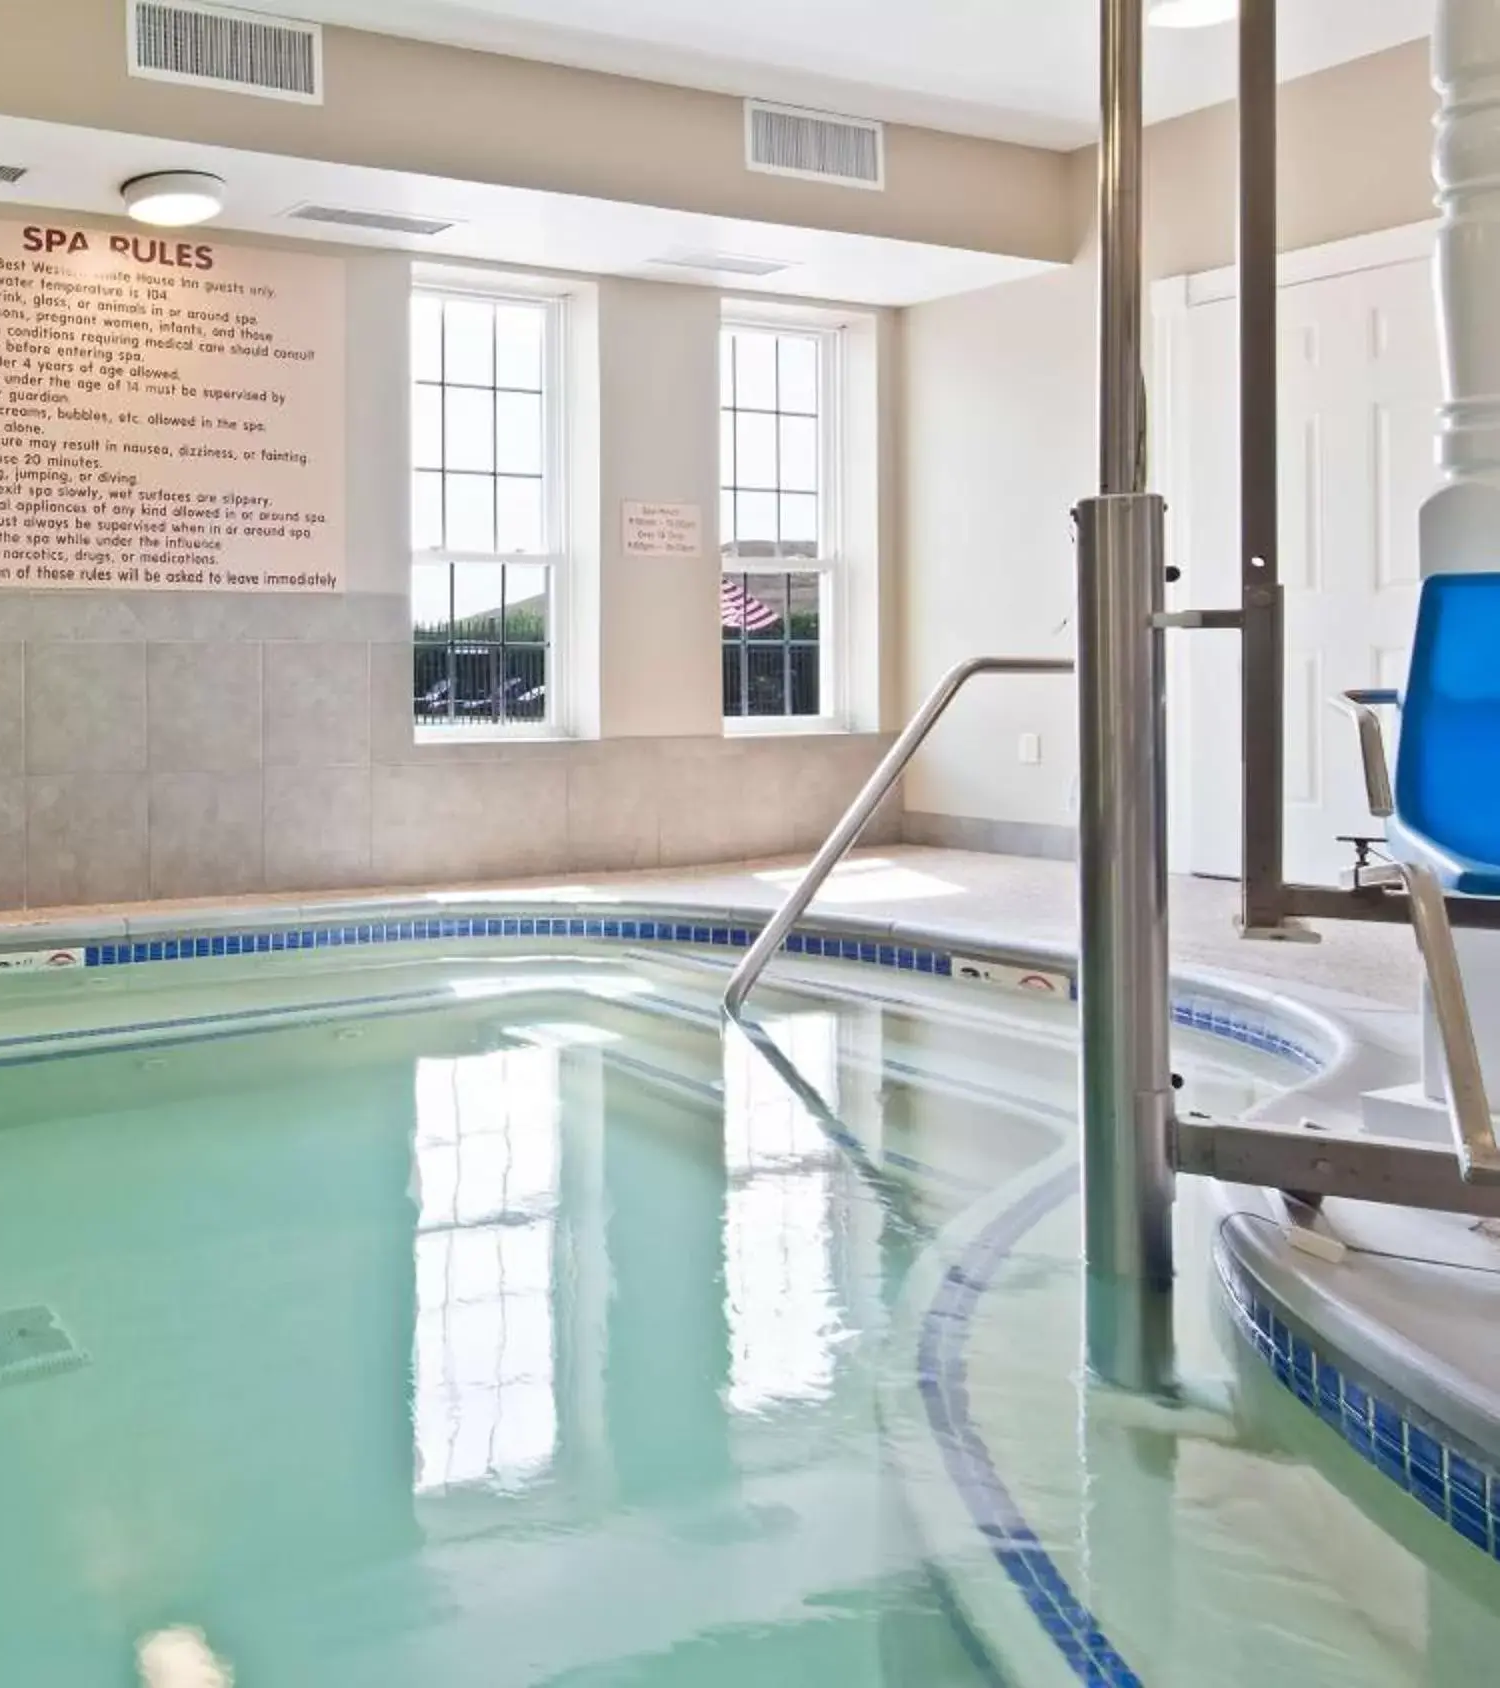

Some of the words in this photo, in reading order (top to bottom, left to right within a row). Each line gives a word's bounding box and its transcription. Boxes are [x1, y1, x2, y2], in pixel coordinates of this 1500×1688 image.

[23, 227, 89, 255] SPA
[109, 237, 212, 268] RULES
[129, 286, 138, 298] is
[77, 301, 90, 309] or
[151, 304, 162, 315] in
[168, 309, 181, 317] or
[187, 311, 229, 321] around
[36, 314, 96, 327] pregnant
[212, 327, 234, 338] and
[7, 327, 74, 340] conditions
[81, 333, 139, 349] requiring
[5, 340, 50, 354] before
[57, 347, 112, 362] entering
[22, 358, 30, 369] 4
[37, 362, 73, 373] years
[99, 367, 123, 378] age
[4, 373, 42, 385] under
[49, 376, 70, 387] the
[77, 381, 100, 392] age
[107, 380, 120, 391] of
[145, 386, 176, 395] must
[181, 385, 196, 396] be
[271, 391, 285, 405] by
[147, 414, 196, 427] allowed
[201, 417, 212, 428] in
[29, 440, 56, 452] may
[63, 441, 99, 451] result
[105, 441, 116, 452] in
[243, 452, 255, 460] or
[24, 454, 40, 465] 20
[79, 474, 92, 482] or
[29, 488, 52, 498] spa
[138, 490, 190, 502] surfaces
[93, 503, 106, 514] of
[112, 507, 134, 518] any
[141, 505, 166, 516] kind
[172, 507, 219, 518] allowed
[23, 517, 68, 531] always
[75, 519, 90, 529] be
[97, 521, 165, 533] supervised
[172, 523, 204, 533] when
[209, 524, 220, 534] in
[26, 536, 49, 547] spa
[56, 534, 90, 545] while
[96, 535, 131, 546] under
[139, 536, 159, 547] the
[121, 554, 134, 562] or
[16, 567, 30, 579] of
[37, 567, 74, 580] these
[80, 569, 111, 581] rules
[117, 570, 138, 581] will
[144, 570, 160, 582] be
[165, 571, 202, 583] asked
[209, 573, 221, 583] to
